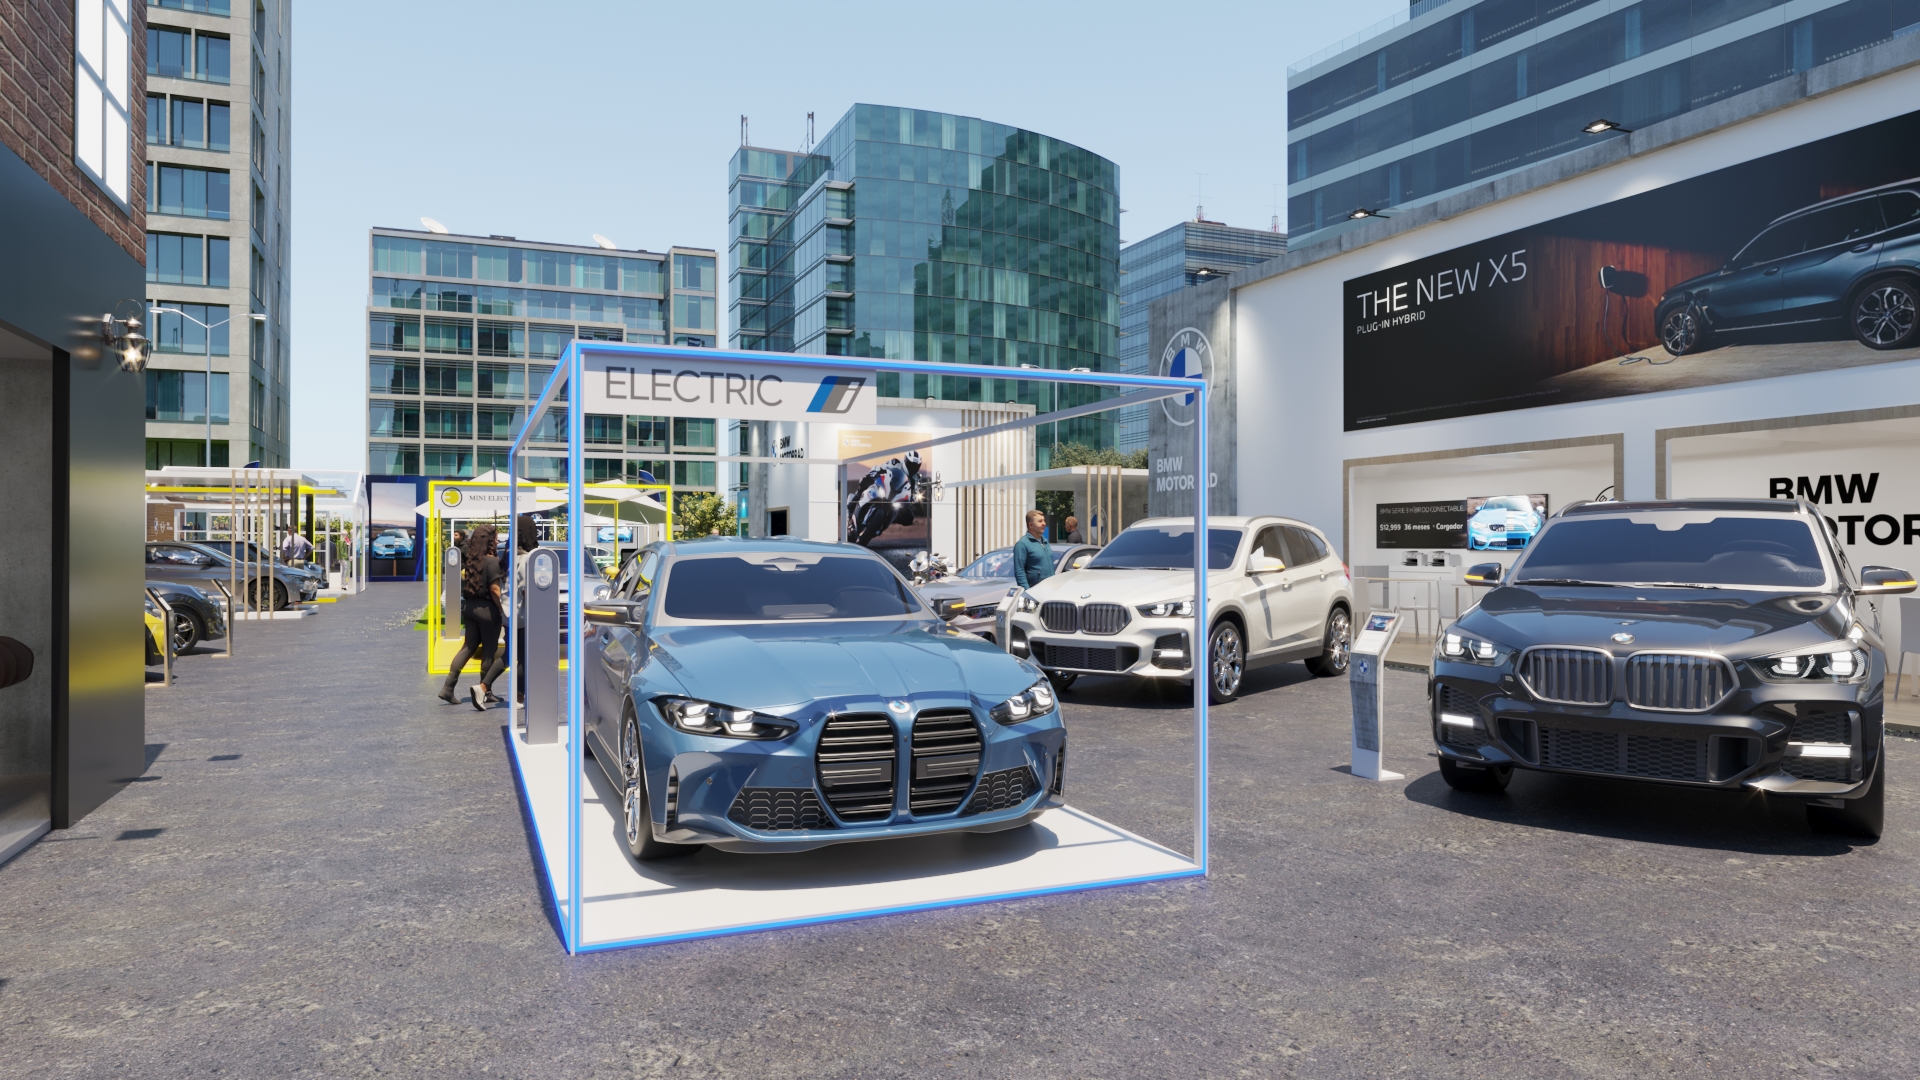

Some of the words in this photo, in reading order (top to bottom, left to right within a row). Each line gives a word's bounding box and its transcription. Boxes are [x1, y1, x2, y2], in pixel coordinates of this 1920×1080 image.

[1356, 281, 1409, 319] THE
[1416, 261, 1480, 305] NEW
[1488, 248, 1528, 288] X5
[1356, 318, 1391, 335] PLUG-IN
[1392, 310, 1426, 327] HYBRID
[1166, 332, 1206, 363] BMW
[605, 365, 784, 407] ELECTRIC
[1156, 456, 1183, 474] BMW
[1156, 472, 1218, 492] MOTORD
[1769, 472, 1880, 505] BMW
[1404, 523, 1412, 531] 36
[1412, 523, 1430, 531] meses
